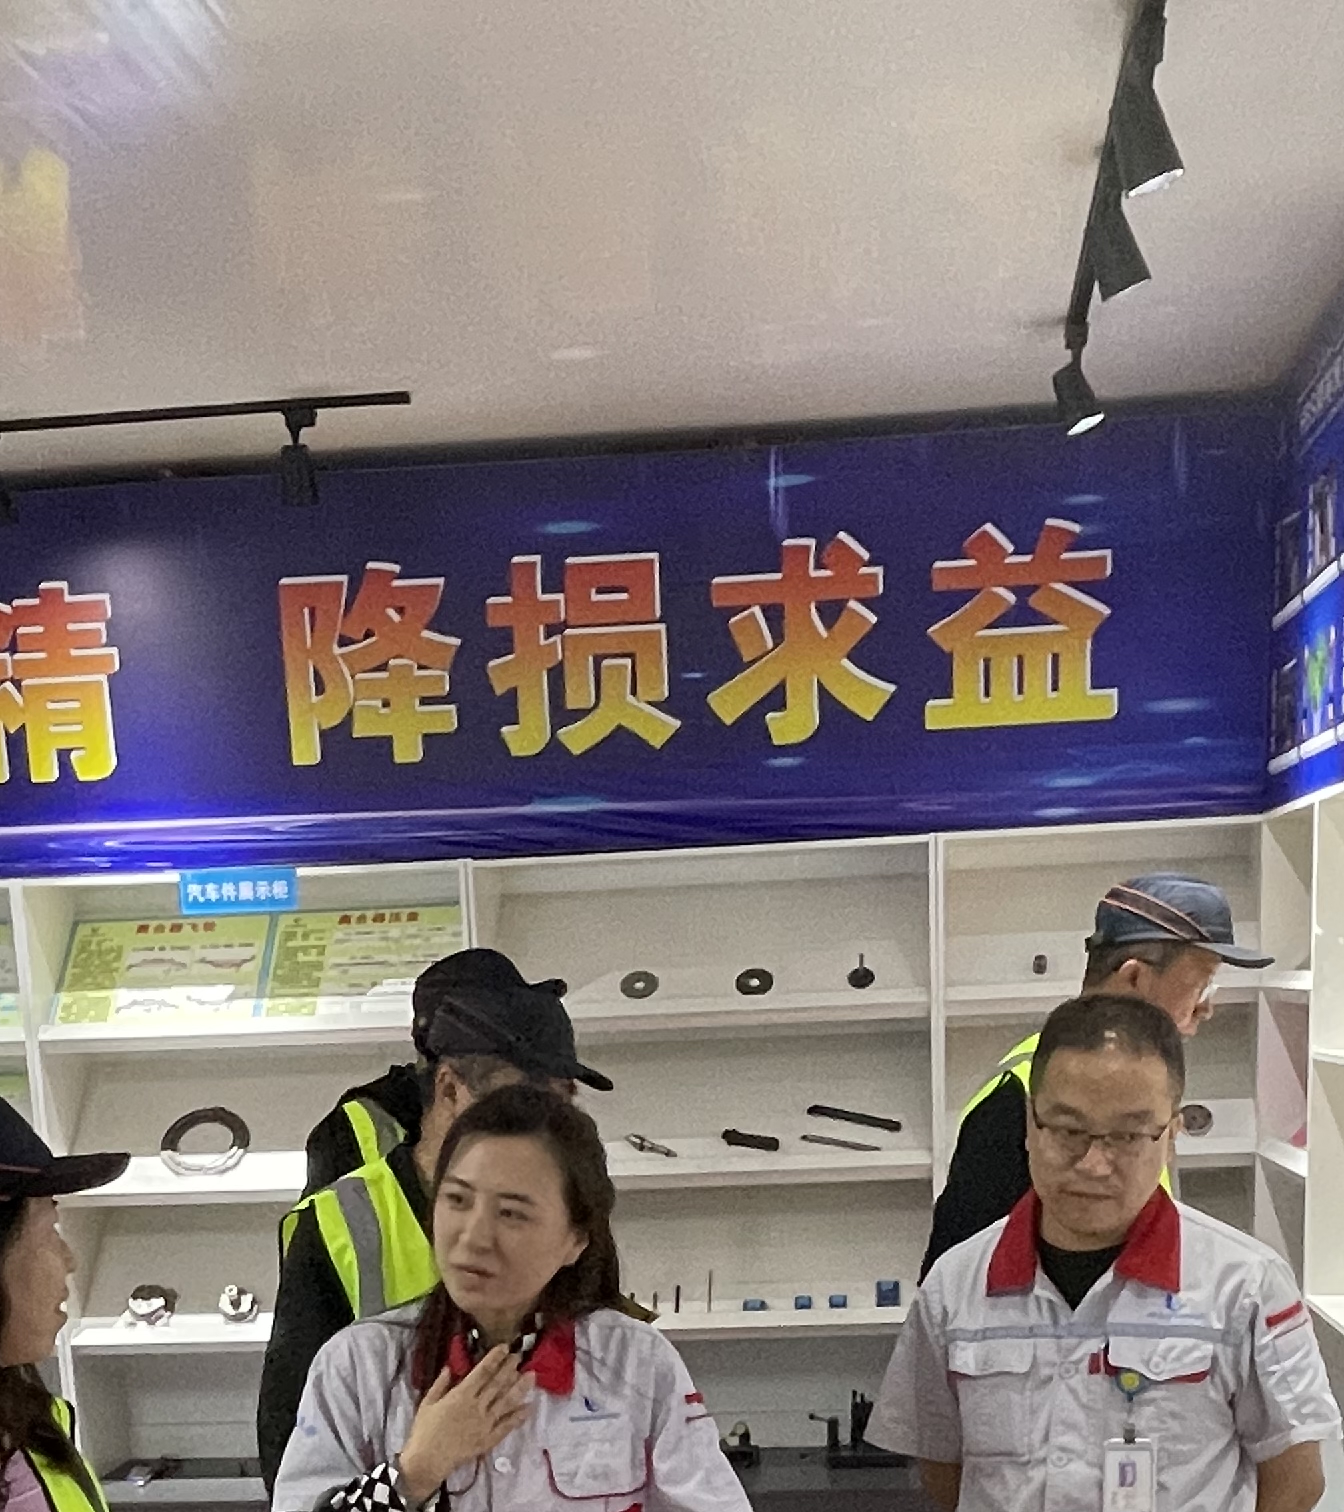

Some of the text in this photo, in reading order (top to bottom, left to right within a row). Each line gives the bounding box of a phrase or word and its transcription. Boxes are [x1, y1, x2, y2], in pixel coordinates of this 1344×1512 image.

[278, 518, 1117, 766] 降损求益
[186, 880, 289, 903] 汽车件展示柜
